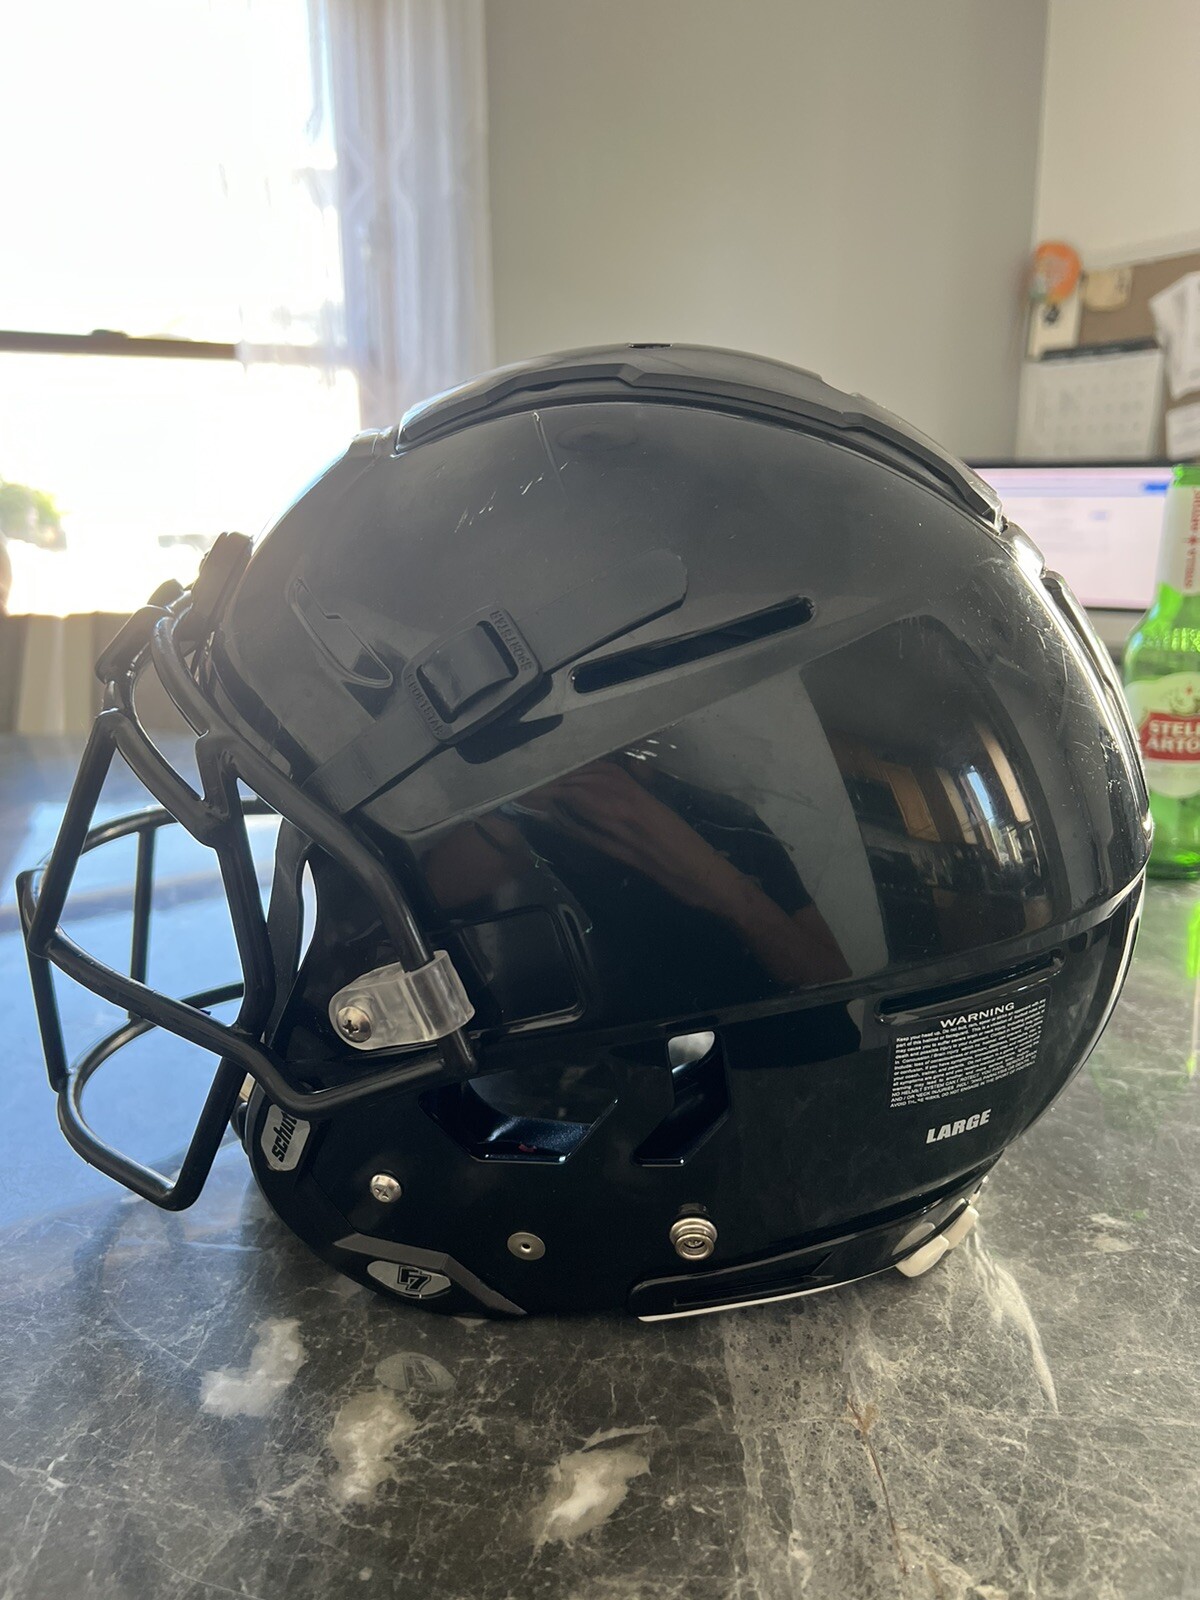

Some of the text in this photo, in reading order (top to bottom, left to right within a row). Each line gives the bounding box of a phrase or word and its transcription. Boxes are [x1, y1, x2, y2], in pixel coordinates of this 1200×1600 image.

[1149, 719, 1200, 737] STEL
[940, 1002, 1015, 1029] WARNING
[926, 1108, 992, 1144] LARGE
[397, 1264, 432, 1292] F7
